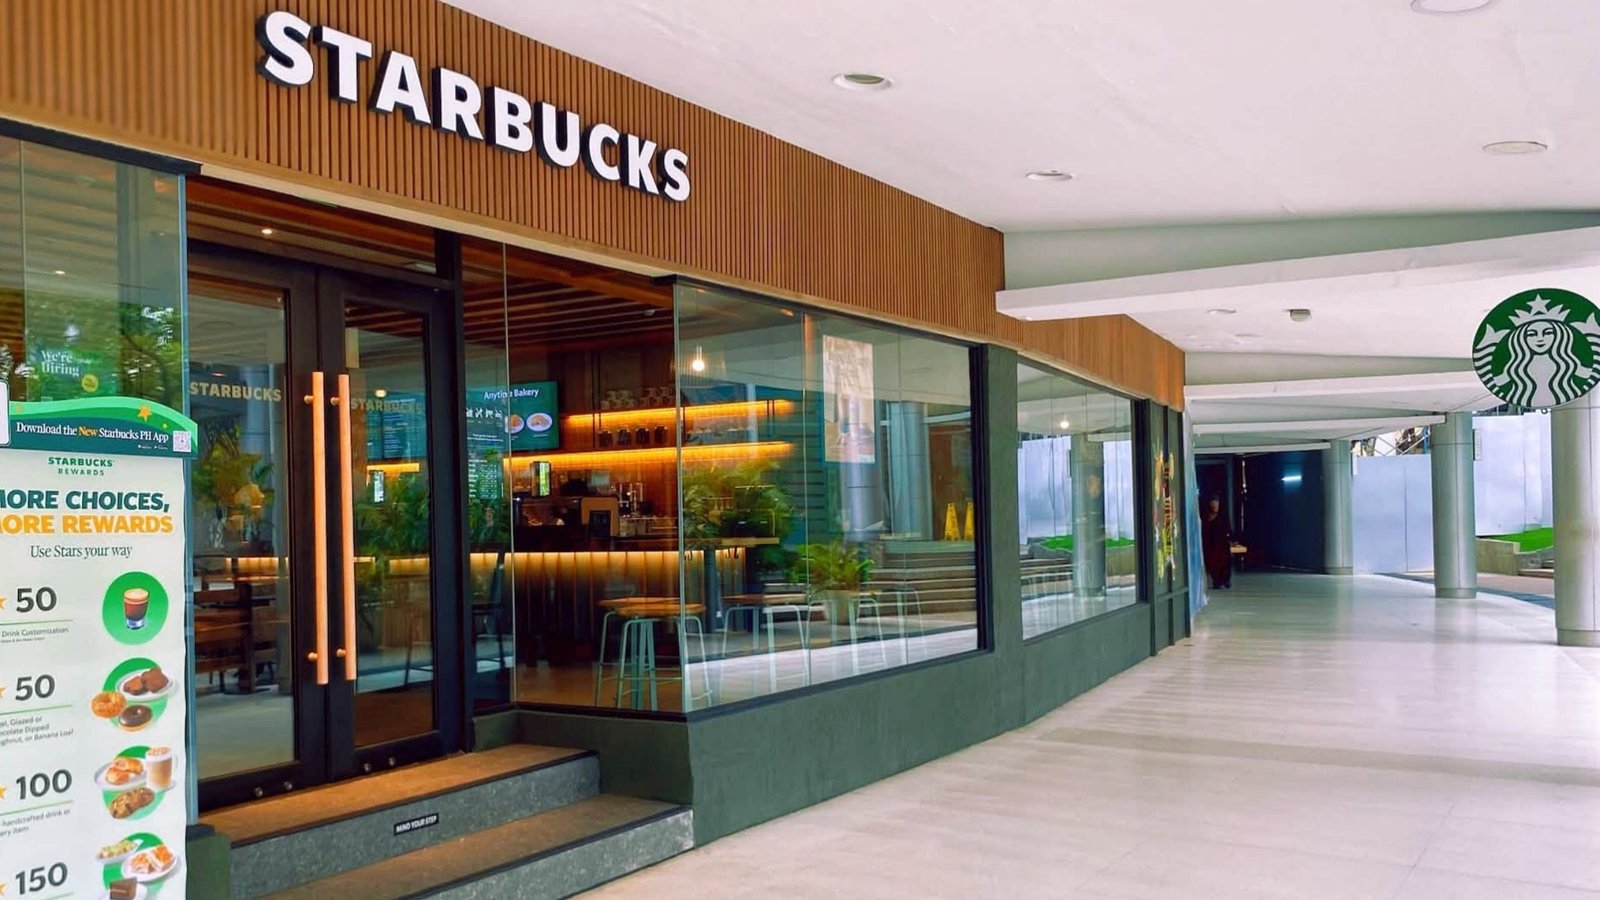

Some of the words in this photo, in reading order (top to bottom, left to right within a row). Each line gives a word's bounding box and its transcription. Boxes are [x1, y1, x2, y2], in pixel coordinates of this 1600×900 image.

[260, 10, 691, 202] STARBUCKS
[189, 381, 282, 402] STARBUCKS
[514, 388, 539, 398] Bakery
[16, 422, 62, 435] Download
[63, 425, 77, 436] the
[78, 426, 98, 437] New
[99, 427, 139, 440] Starbucks
[140, 431, 152, 440] PH
[153, 432, 169, 443] App
[48, 457, 113, 467] STARBUCKS
[58, 468, 105, 476] REWARDS
[65, 490, 170, 513] CHOICES,
[0, 514, 55, 534] ORE
[62, 515, 173, 533] REWARDS
[30, 545, 51, 558] Use
[53, 545, 83, 557] Stars
[83, 548, 109, 559] your
[111, 548, 132, 559] way
[16, 586, 57, 613] 50
[1, 630, 20, 638] Drink
[15, 674, 56, 701] 50
[25, 723, 50, 733] Dipped
[34, 732, 59, 740] Banana
[60, 728, 74, 736] Loaf
[16, 769, 73, 800] 100
[411, 818, 425, 829] YOUR
[425, 815, 437, 825] STEP
[15, 862, 68, 895] 150
